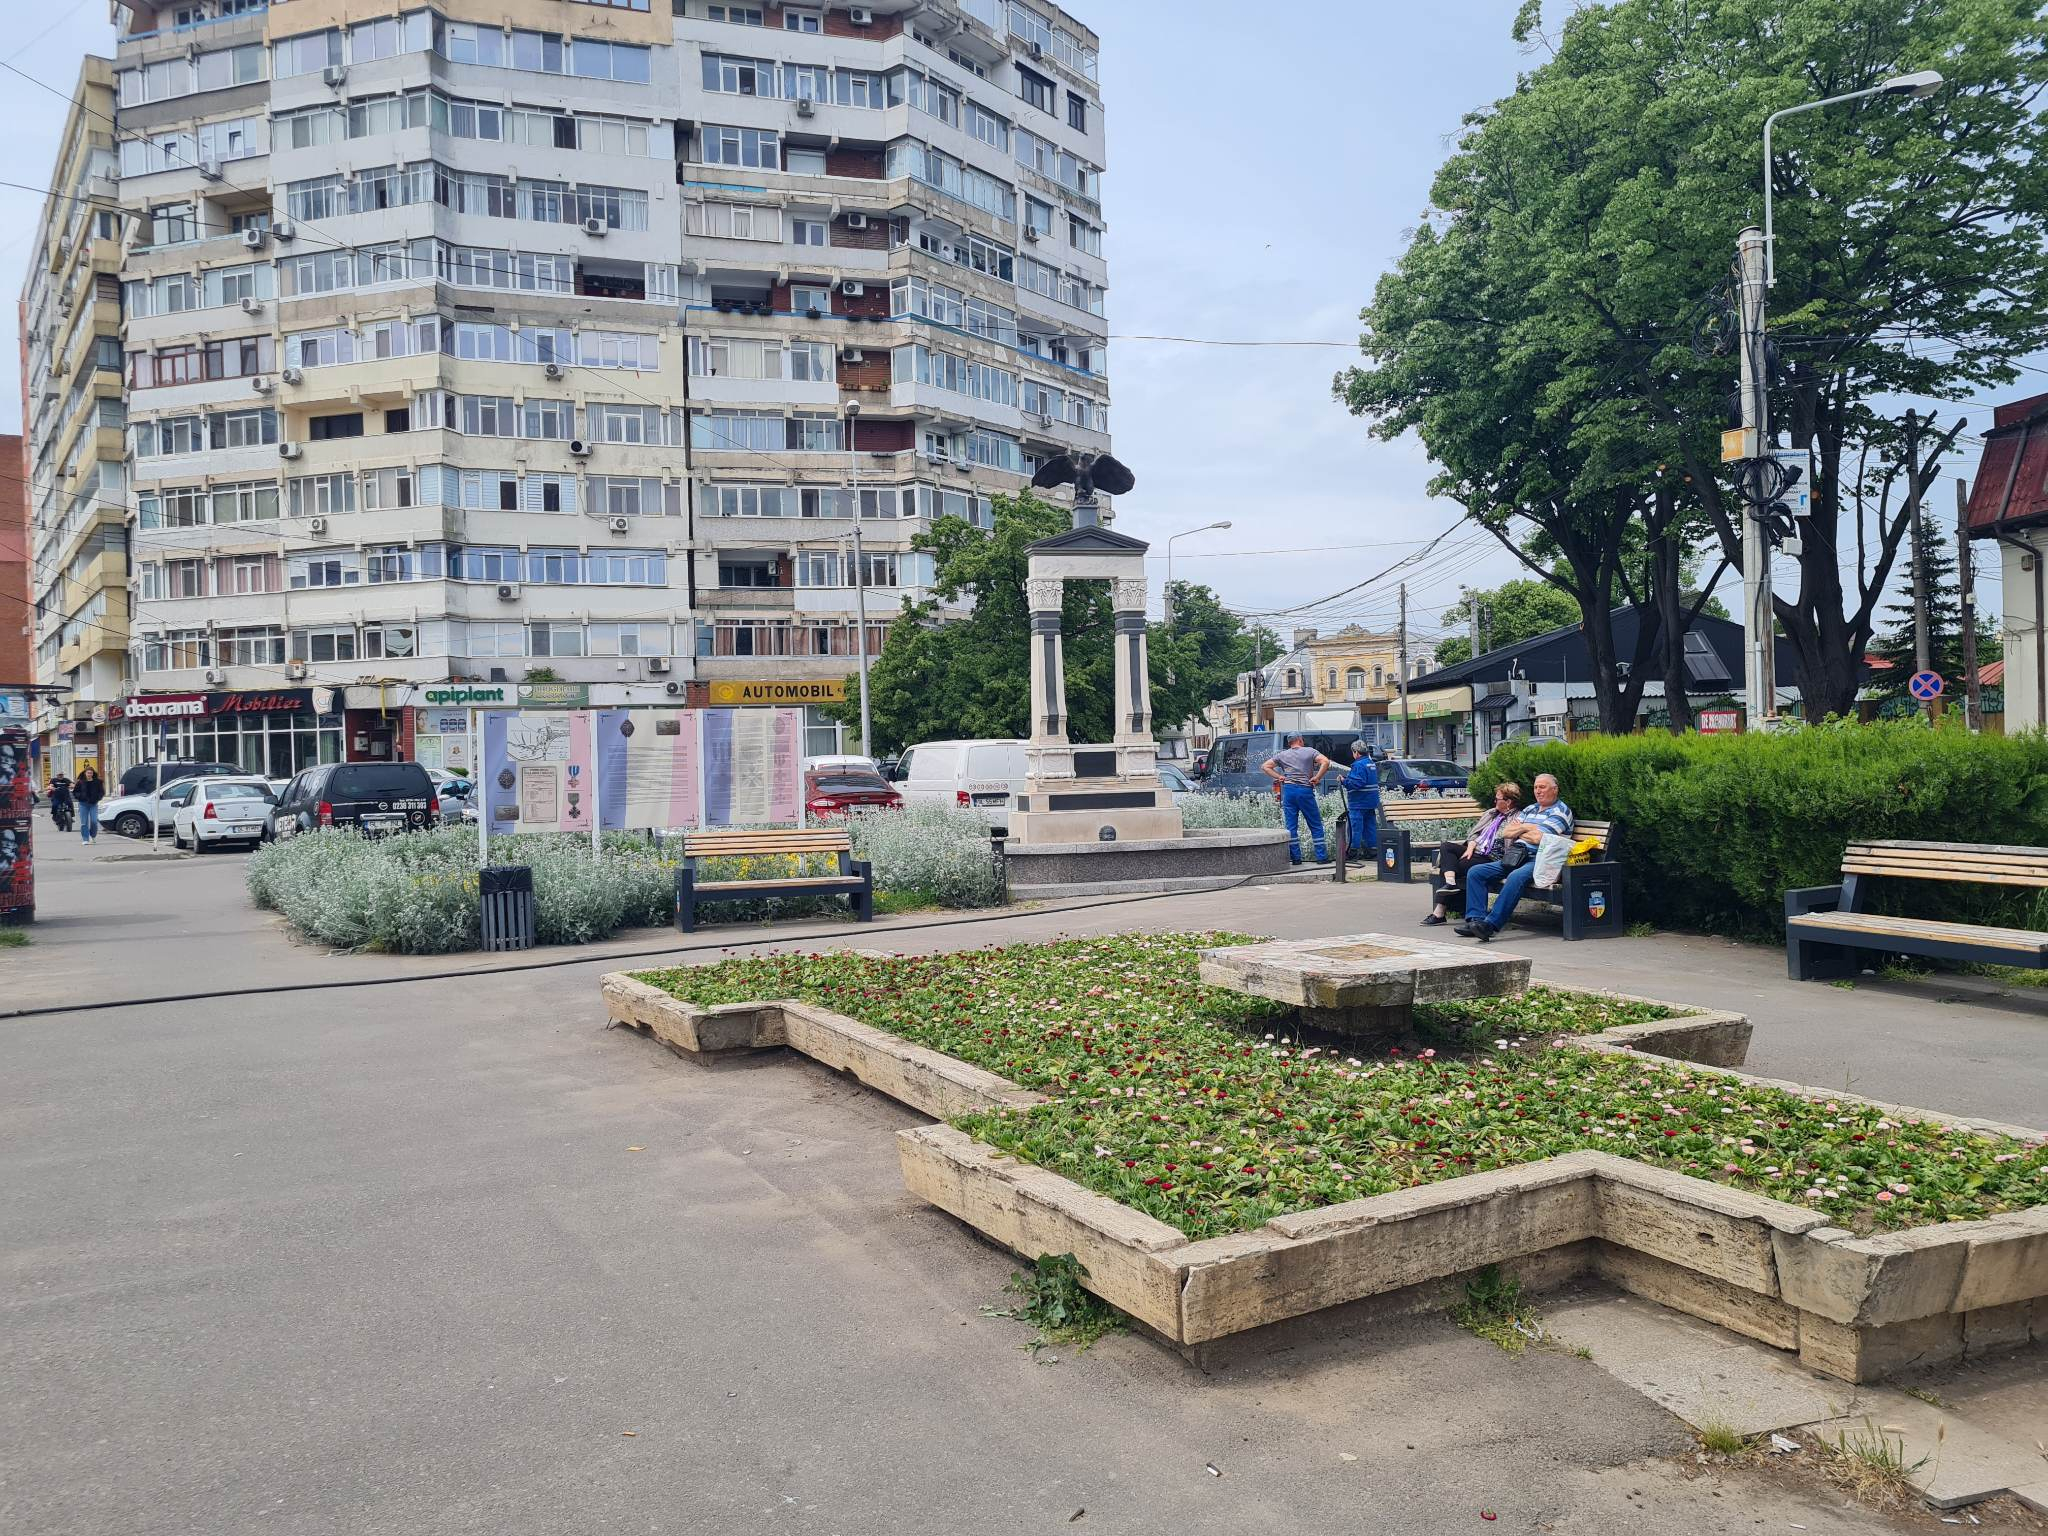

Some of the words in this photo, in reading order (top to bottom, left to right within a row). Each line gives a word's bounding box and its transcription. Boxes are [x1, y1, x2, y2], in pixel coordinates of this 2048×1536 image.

[425, 686, 504, 705] apiplant
[743, 685, 834, 698] AUTOMOBIL
[126, 699, 205, 718] decorama
